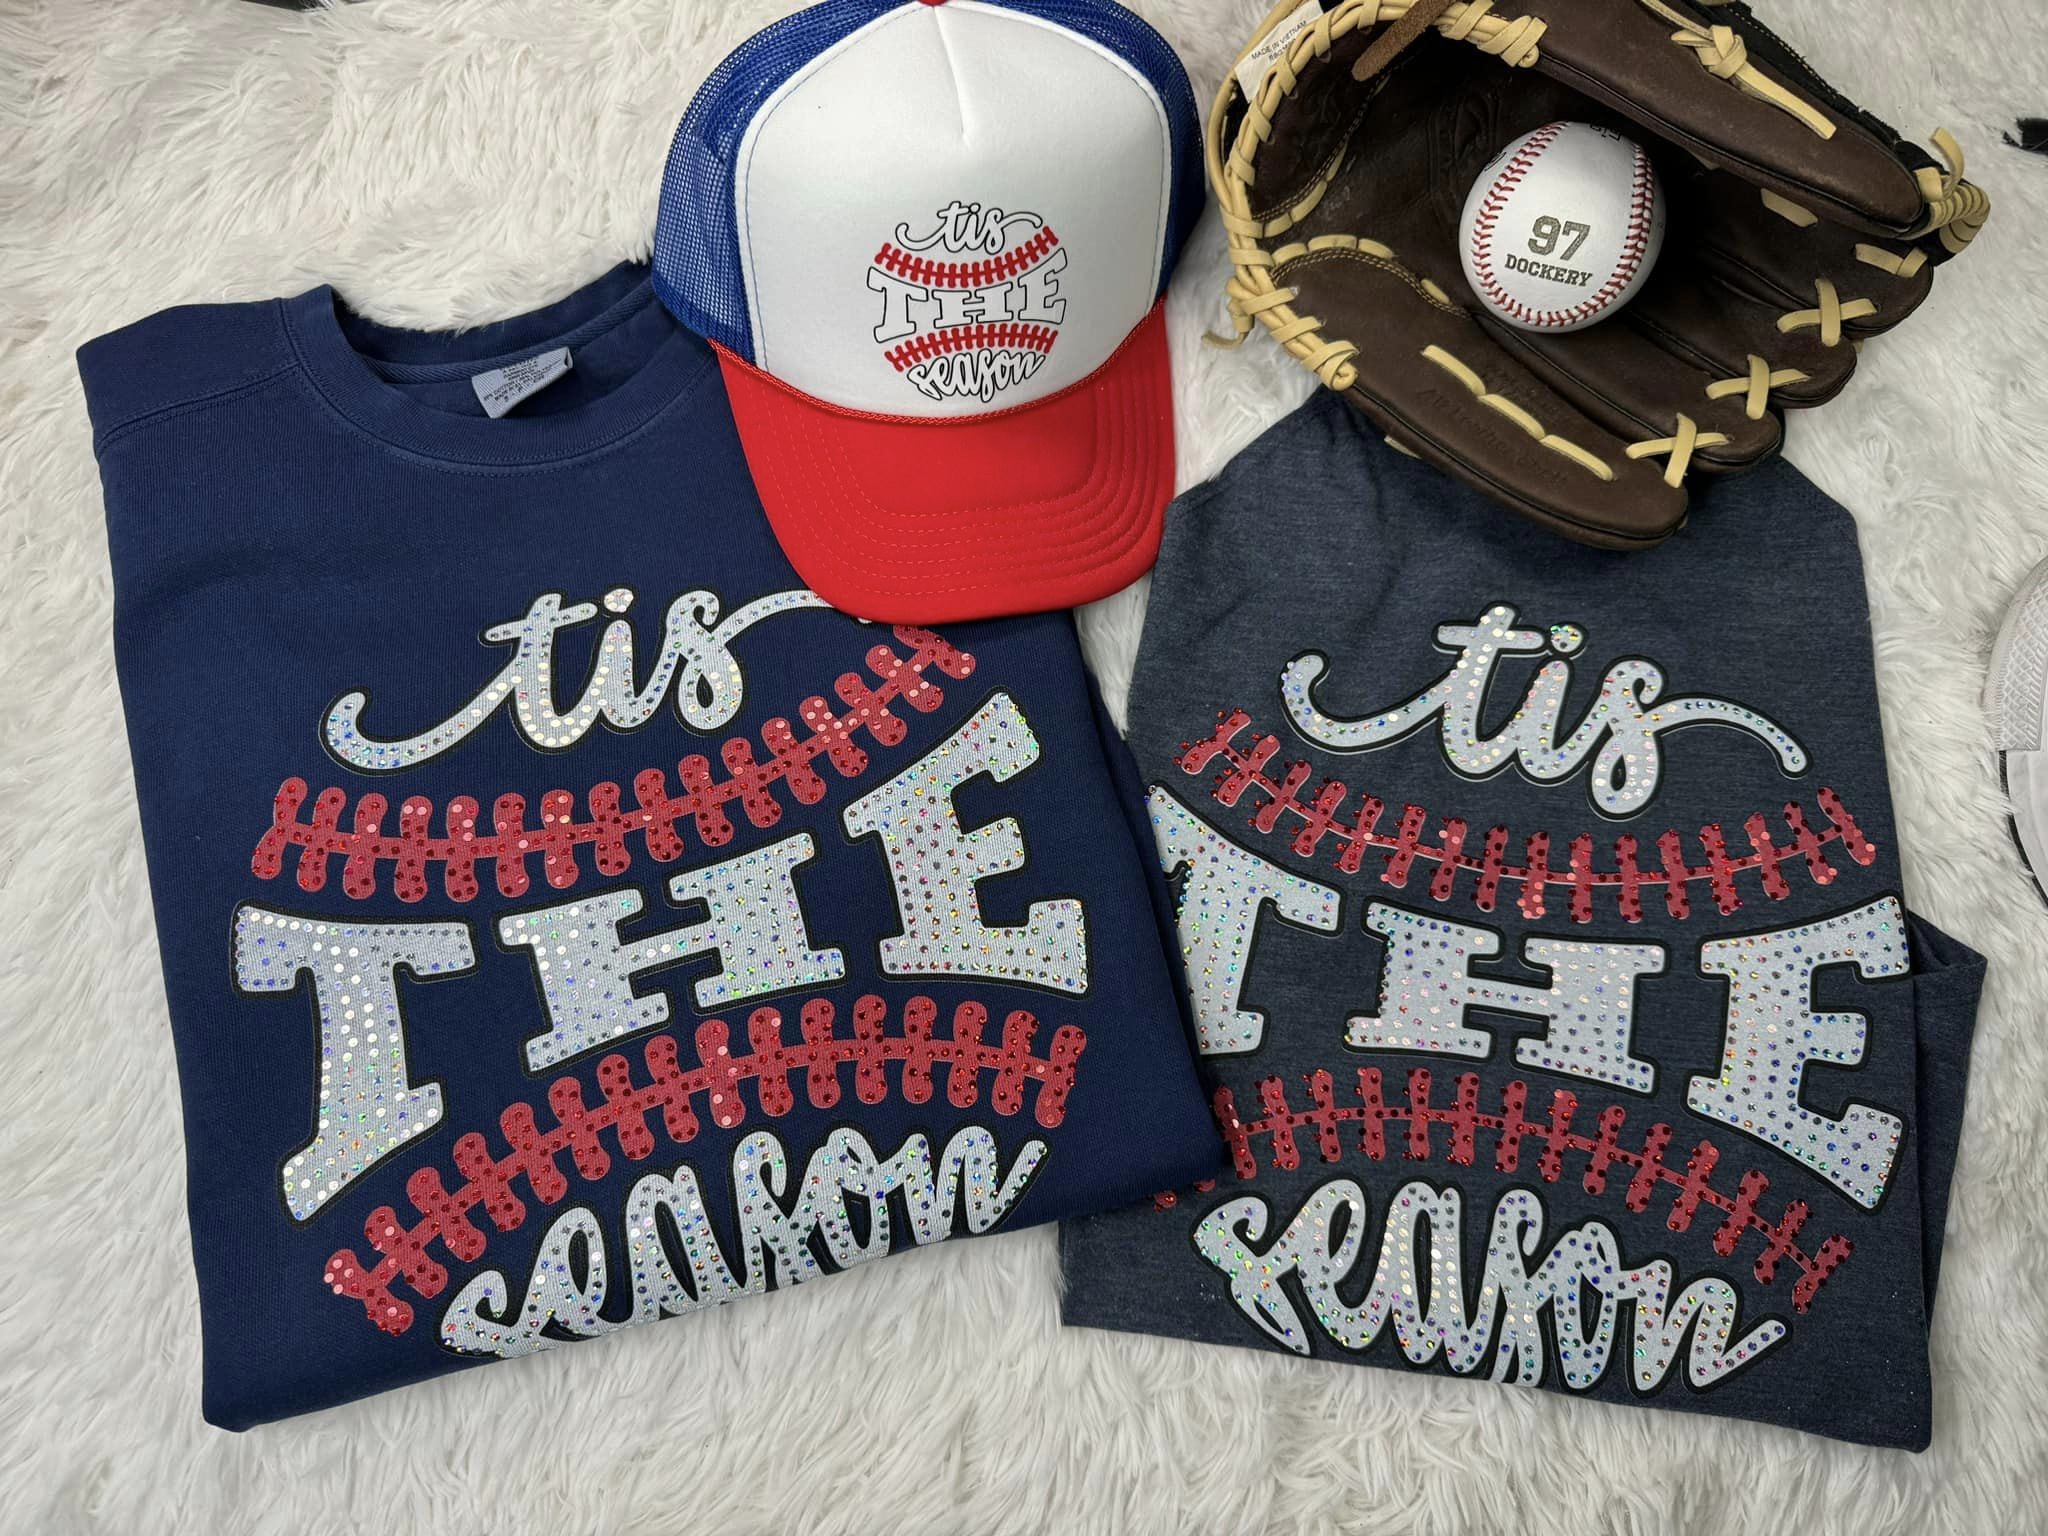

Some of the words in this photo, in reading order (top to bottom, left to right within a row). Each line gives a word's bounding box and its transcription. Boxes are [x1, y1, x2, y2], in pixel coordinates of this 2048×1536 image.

[1251, 45, 1272, 60] MADE
[1279, 20, 1307, 44] VIETNAM
[866, 247, 1068, 344] THE
[895, 200, 1043, 255] tis
[1504, 254, 1594, 287] DOCKERY
[1527, 215, 1591, 261] 97
[906, 348, 1046, 403] season
[319, 586, 872, 776] tis
[1277, 602, 1814, 821] tis
[229, 688, 1091, 1226] THE
[1146, 783, 1915, 1214] THE
[434, 1123, 1053, 1360] season
[1189, 1178, 1797, 1397] season
